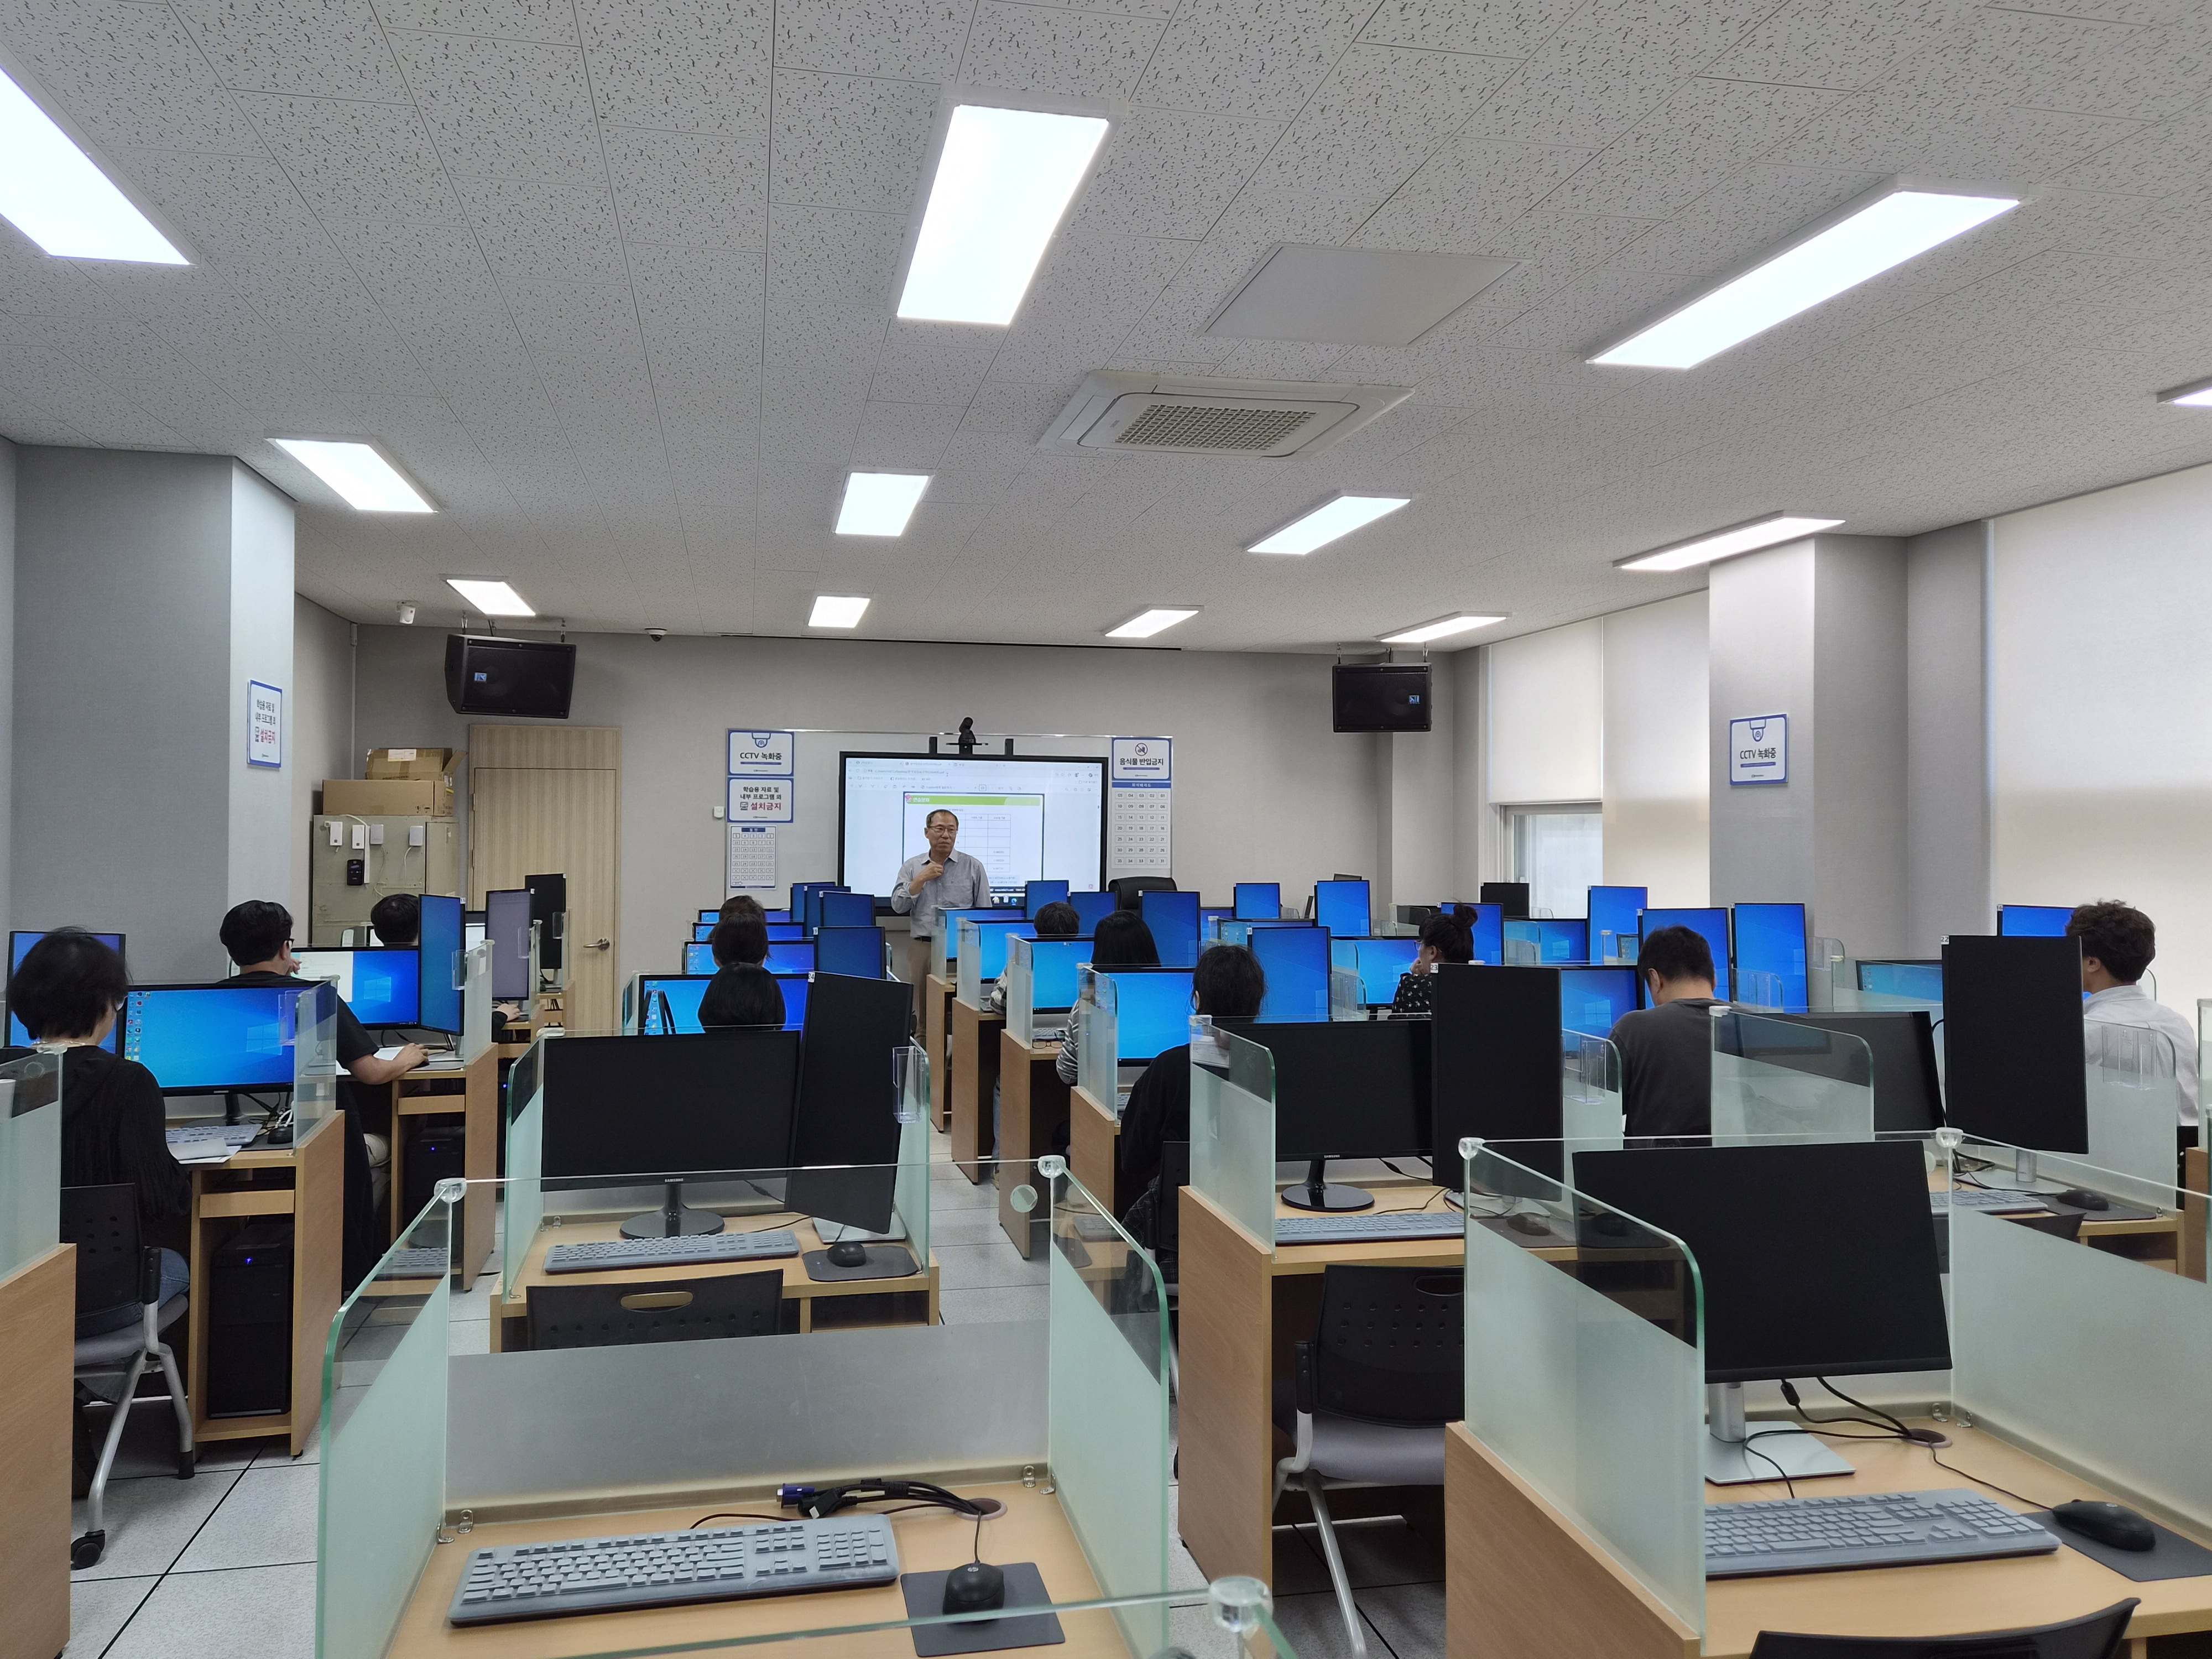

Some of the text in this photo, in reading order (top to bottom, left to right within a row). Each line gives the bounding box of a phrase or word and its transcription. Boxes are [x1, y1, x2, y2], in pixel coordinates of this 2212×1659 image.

[260, 729, 275, 744] 설치금지
[1740, 748, 1776, 759] CCTV 녹화중
